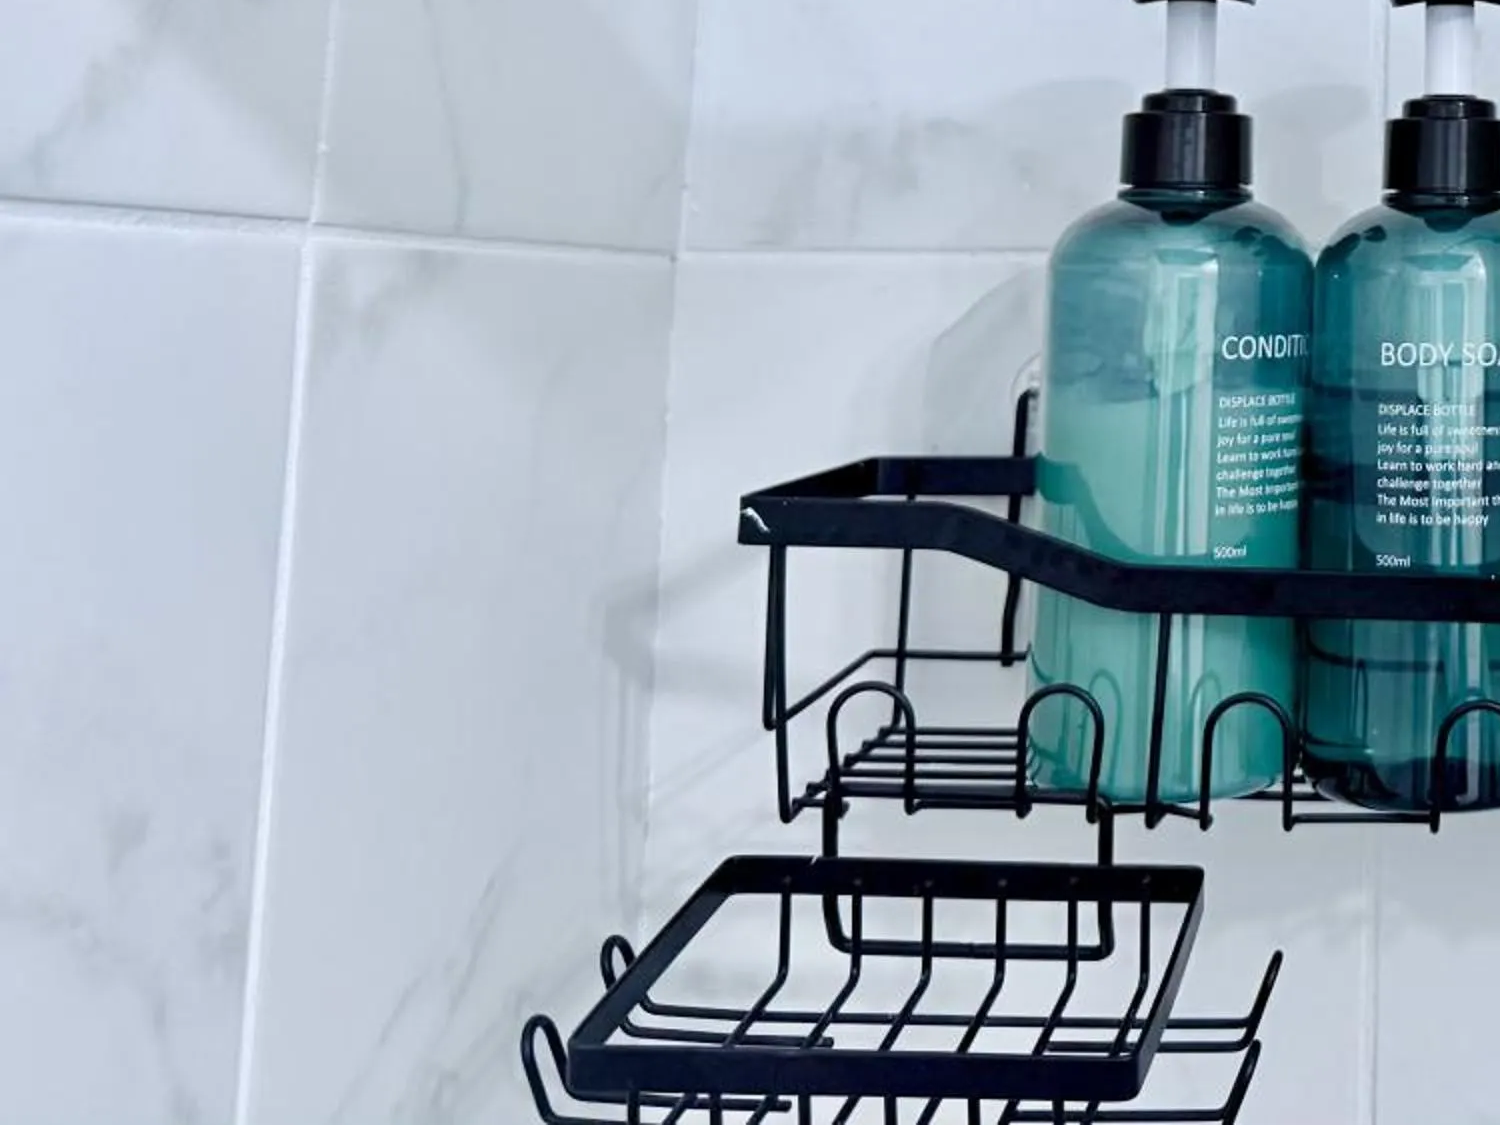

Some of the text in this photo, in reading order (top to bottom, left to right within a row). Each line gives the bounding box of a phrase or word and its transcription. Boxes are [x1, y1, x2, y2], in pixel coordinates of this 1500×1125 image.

[1380, 341, 1455, 367] BODY
[1377, 402, 1431, 416] DISPLACE
[1377, 423, 1397, 436] Life
[1399, 423, 1408, 436] is
[1410, 423, 1429, 436] full
[1377, 441, 1394, 455] joy
[1396, 441, 1412, 454] for
[1415, 444, 1422, 454] a
[1216, 451, 1247, 464] Learn
[1377, 458, 1408, 471] Learn
[1410, 459, 1423, 472] to
[1425, 459, 1456, 473] work
[1457, 458, 1483, 472] hard
[1377, 476, 1430, 492] challenge
[1216, 485, 1236, 499] The
[1377, 493, 1397, 507] The
[1399, 494, 1430, 508] Most
[1376, 511, 1490, 528] in life is to be happy
[1375, 554, 1412, 568] 500ml
